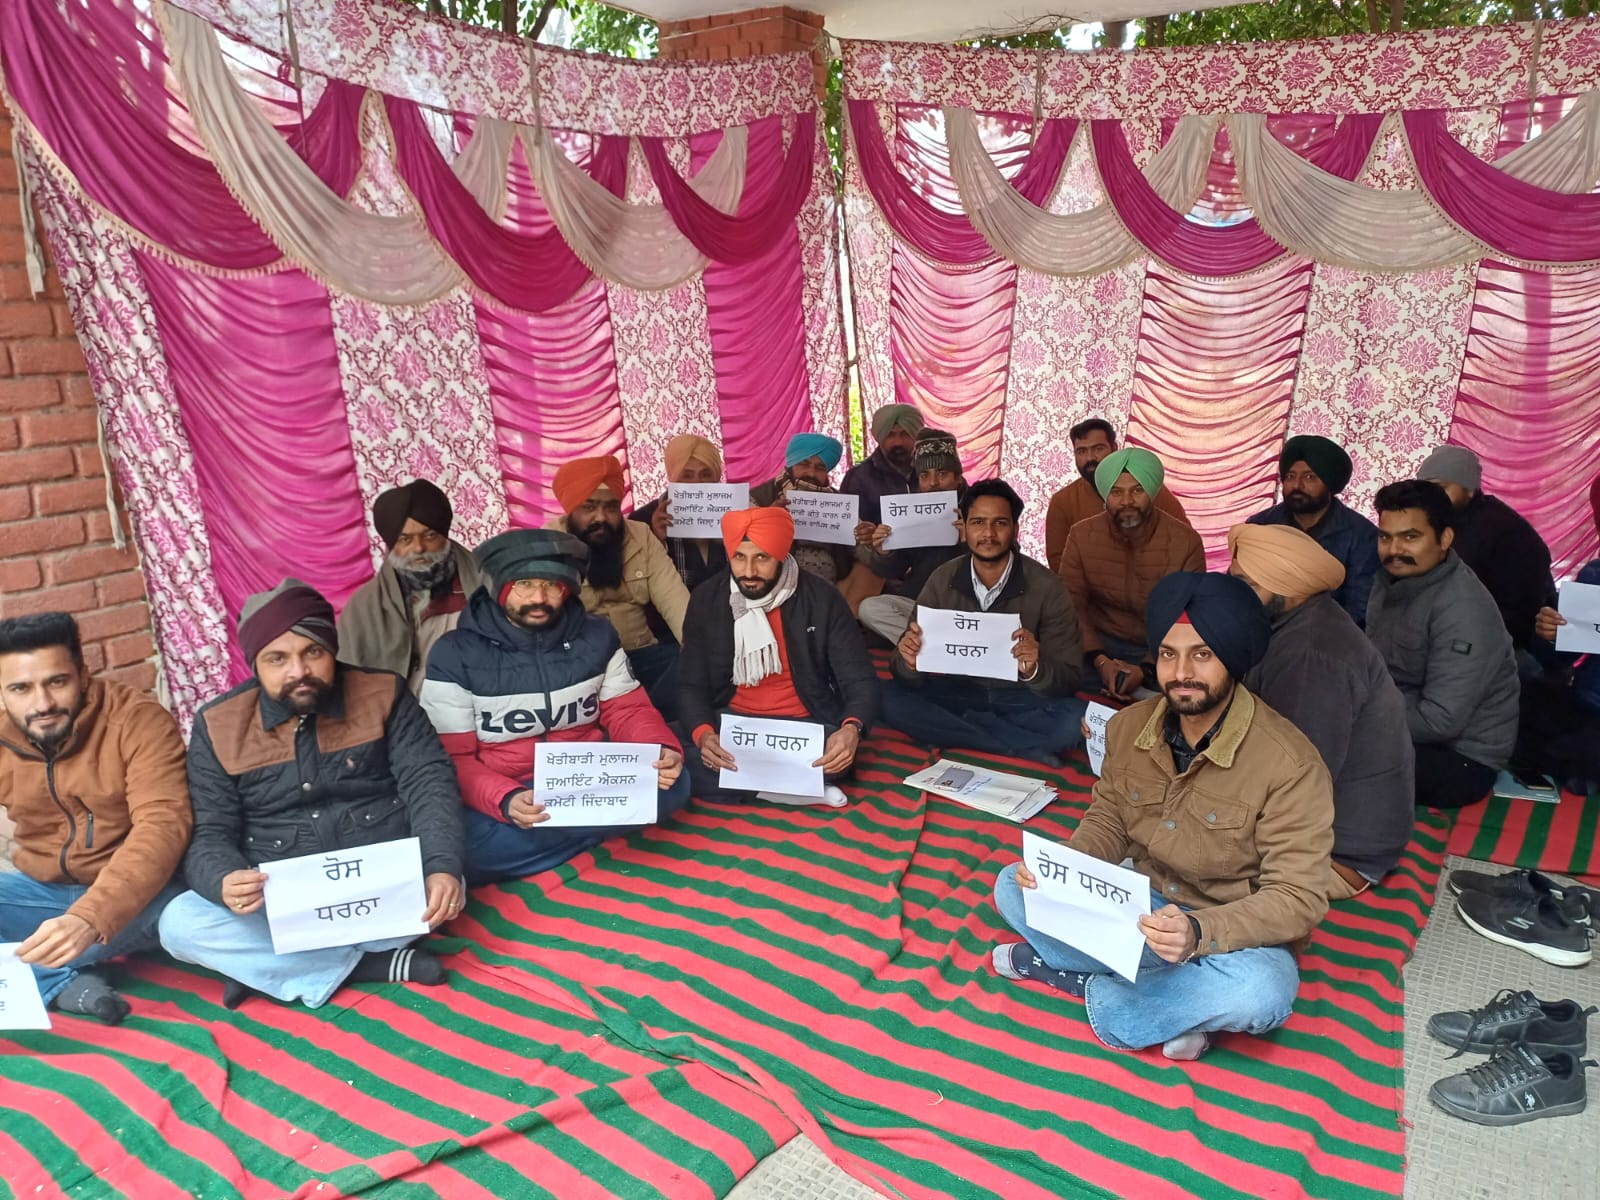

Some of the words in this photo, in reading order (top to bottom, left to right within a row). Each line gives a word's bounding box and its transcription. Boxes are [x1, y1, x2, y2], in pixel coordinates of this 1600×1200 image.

[888, 502, 909, 517] ਰੋਸ
[914, 502, 947, 516] ਧਰਨਾ
[953, 613, 980, 631] ਰੋਸ
[945, 643, 988, 658] ਧਰਨਾ
[731, 725, 758, 748] ਰੋਸ
[765, 734, 810, 751] ਧਰਨਾ
[546, 752, 595, 766] ਖੇਤੀਬਾੜੀ
[599, 754, 640, 766] ਮੁਲਾਜਮ
[546, 773, 594, 790] ਜੁਆਇੰਟ
[598, 772, 637, 786] ਐਕਸਨ
[544, 795, 576, 808] ਕਮੇਟੀ
[582, 794, 629, 807] ਜਿੰਦਾਬਾਦ
[322, 856, 363, 881] ਰੋਸ
[1036, 849, 1069, 885] ਰੋਸ
[1078, 871, 1132, 904] ਧਰਨਾ
[314, 897, 381, 921] ਧਰਨਾ
